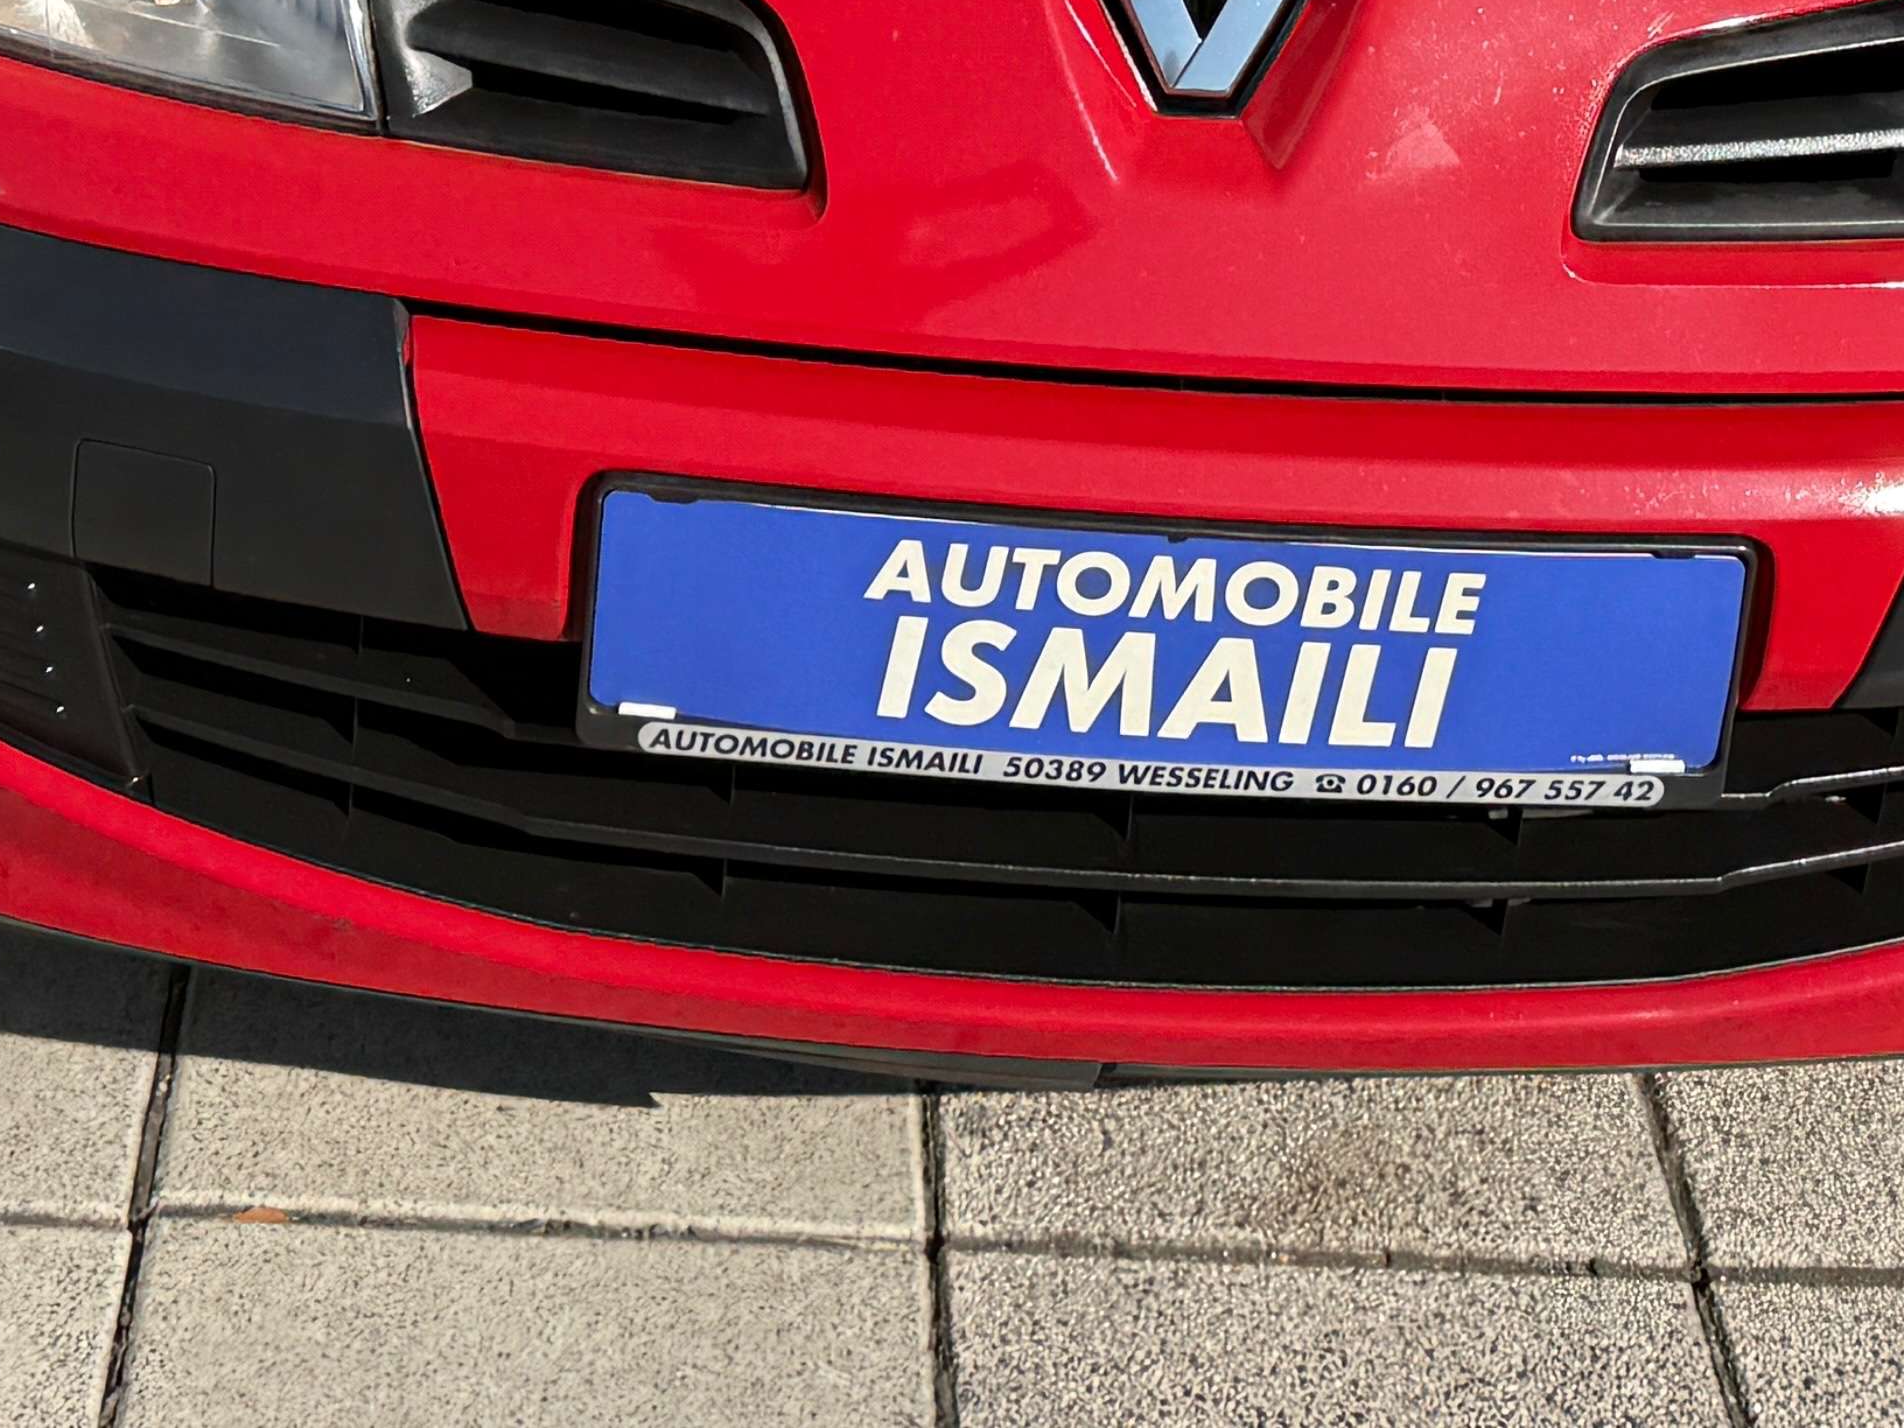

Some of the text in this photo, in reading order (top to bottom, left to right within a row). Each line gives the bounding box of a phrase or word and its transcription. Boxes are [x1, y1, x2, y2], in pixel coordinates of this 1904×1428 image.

[864, 538, 1487, 637] AUTOMOBILE
[876, 615, 1458, 749] ISMAILI
[648, 728, 857, 765] AUTOMOBILE
[867, 746, 983, 775] ISMAILI
[1002, 757, 1107, 784] 50389
[1118, 764, 1295, 794] WESSELING
[1356, 773, 1438, 799] 0160
[1475, 777, 1535, 801] 967
[1544, 779, 1606, 802] 557
[1613, 781, 1655, 803] 42
